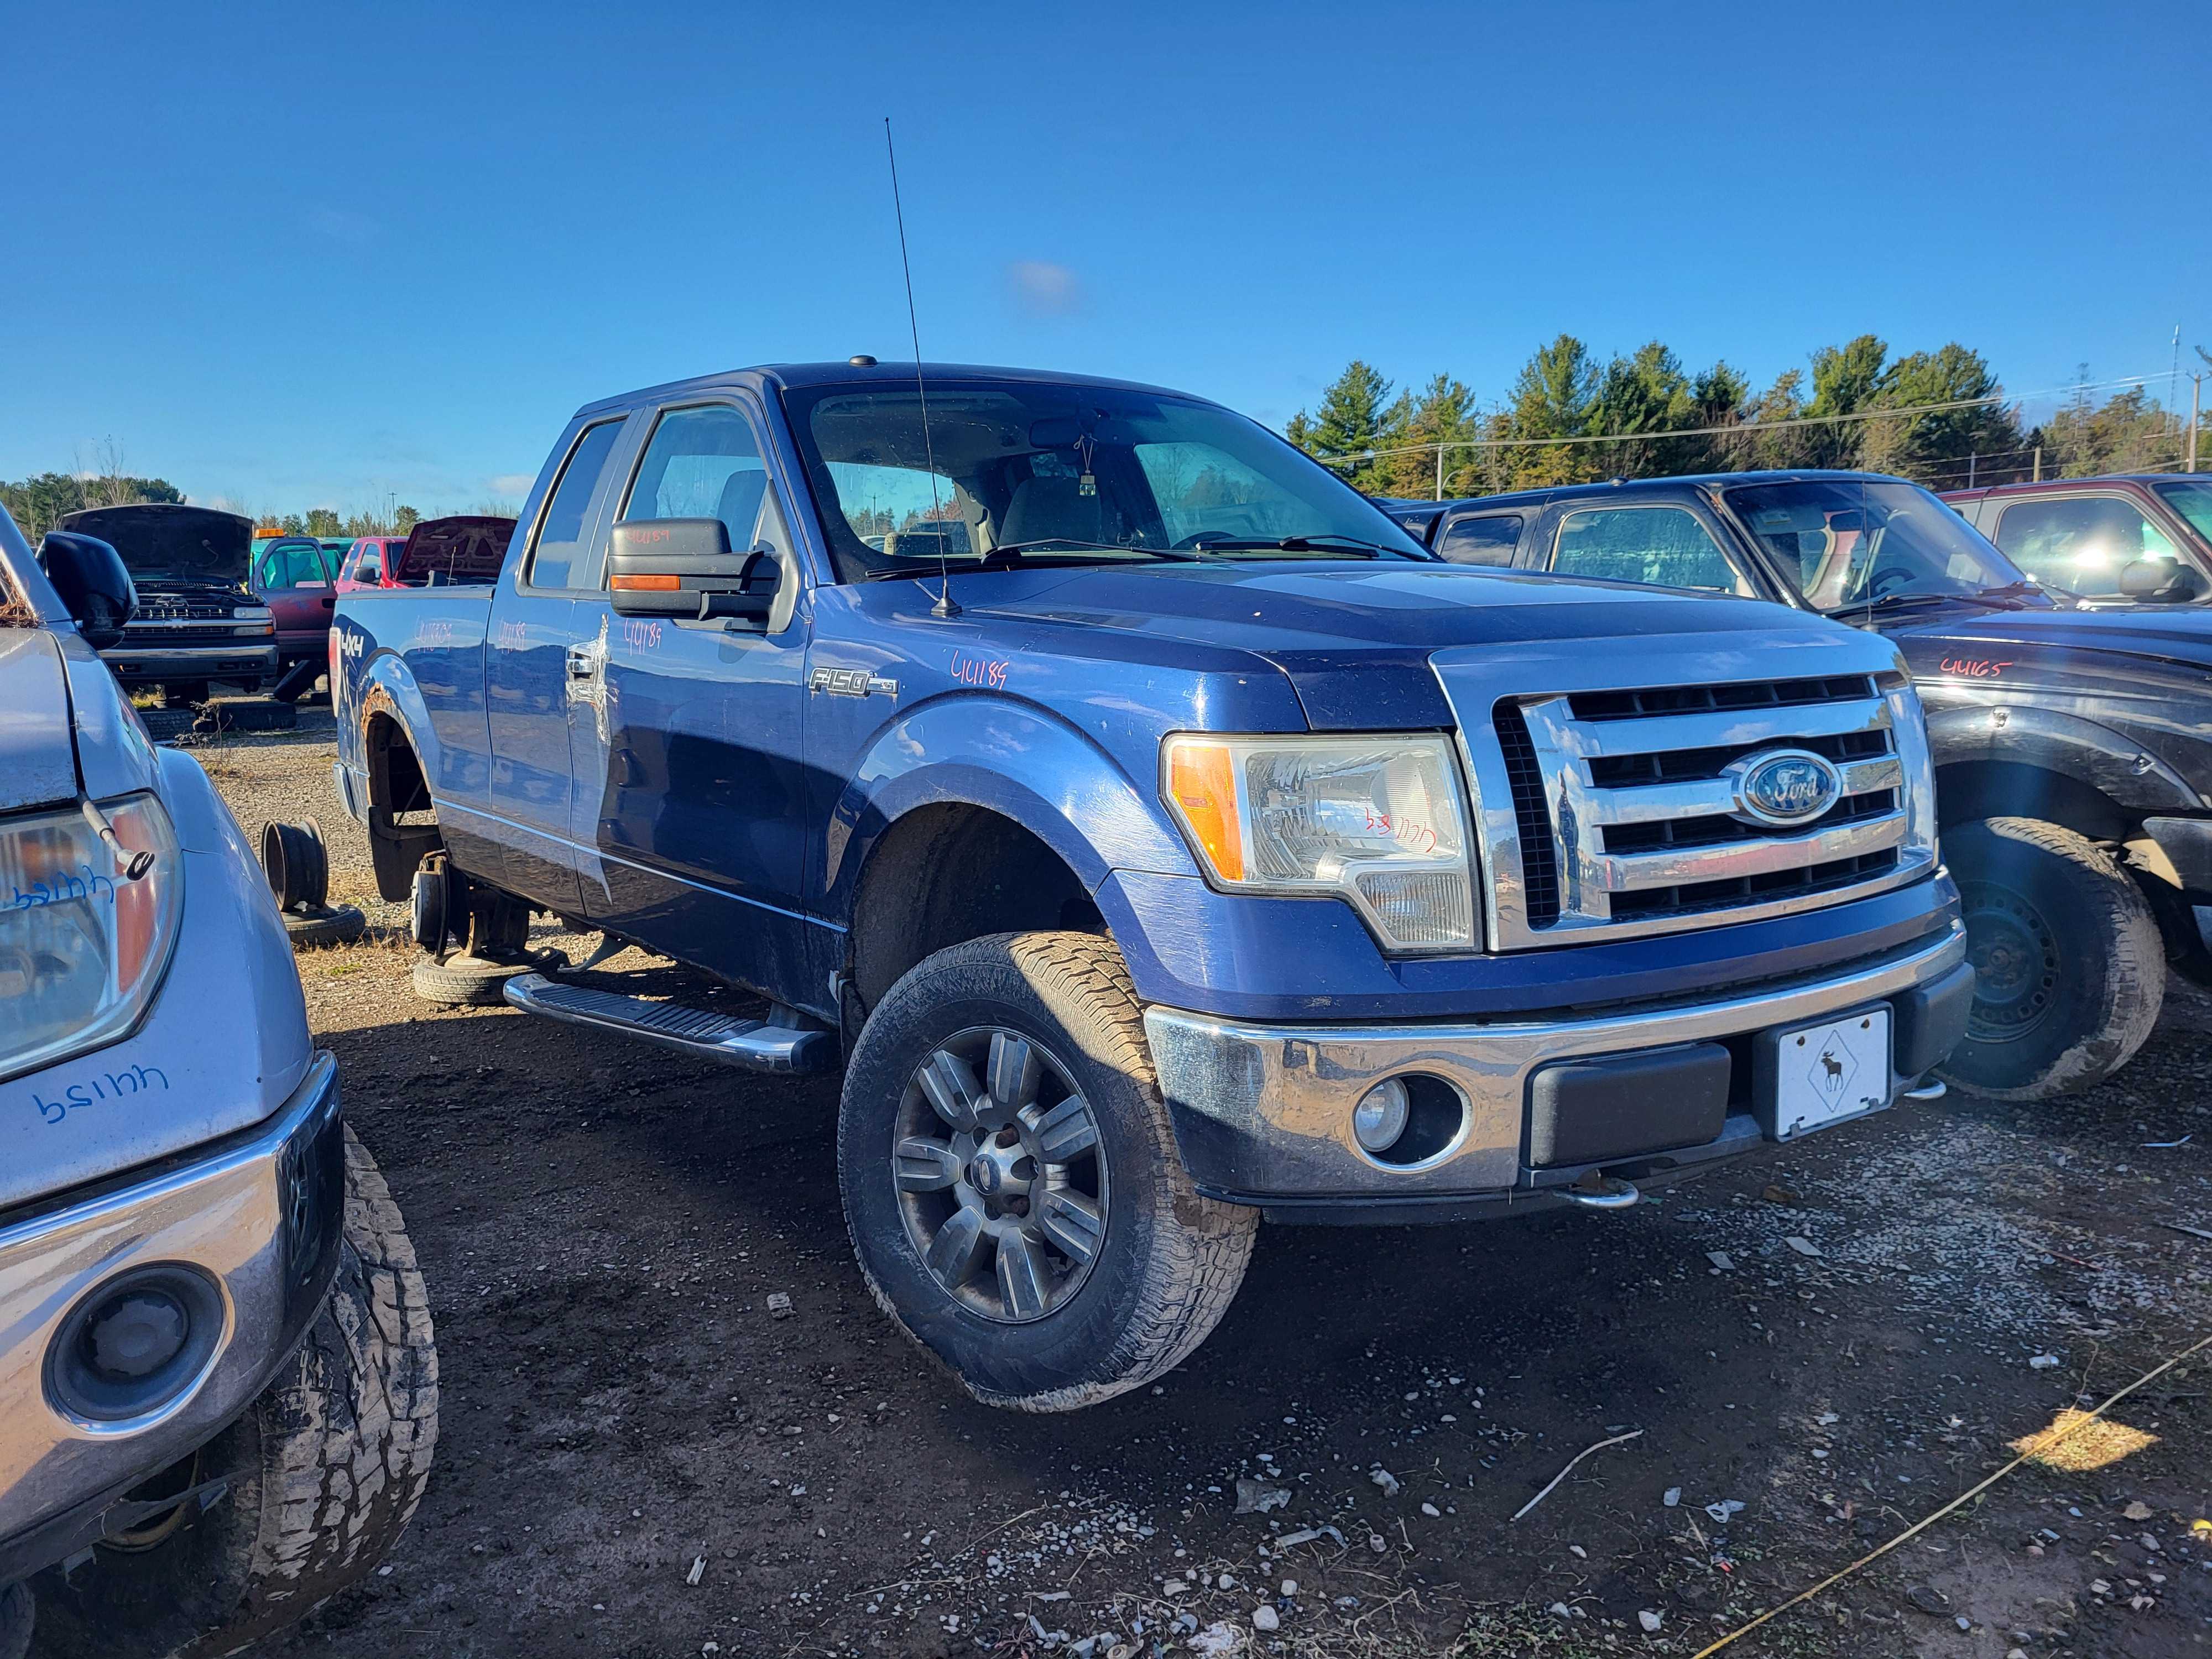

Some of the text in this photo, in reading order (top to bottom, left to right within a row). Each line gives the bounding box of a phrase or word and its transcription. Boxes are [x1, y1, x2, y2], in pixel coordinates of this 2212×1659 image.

[624, 618, 662, 656] 44189
[809, 666, 870, 696] F-150
[950, 649, 1009, 691] 44189
[1940, 657, 2013, 678] 44165
[1774, 769, 1819, 802] Ford
[32, 1064, 169, 1124] 44159
